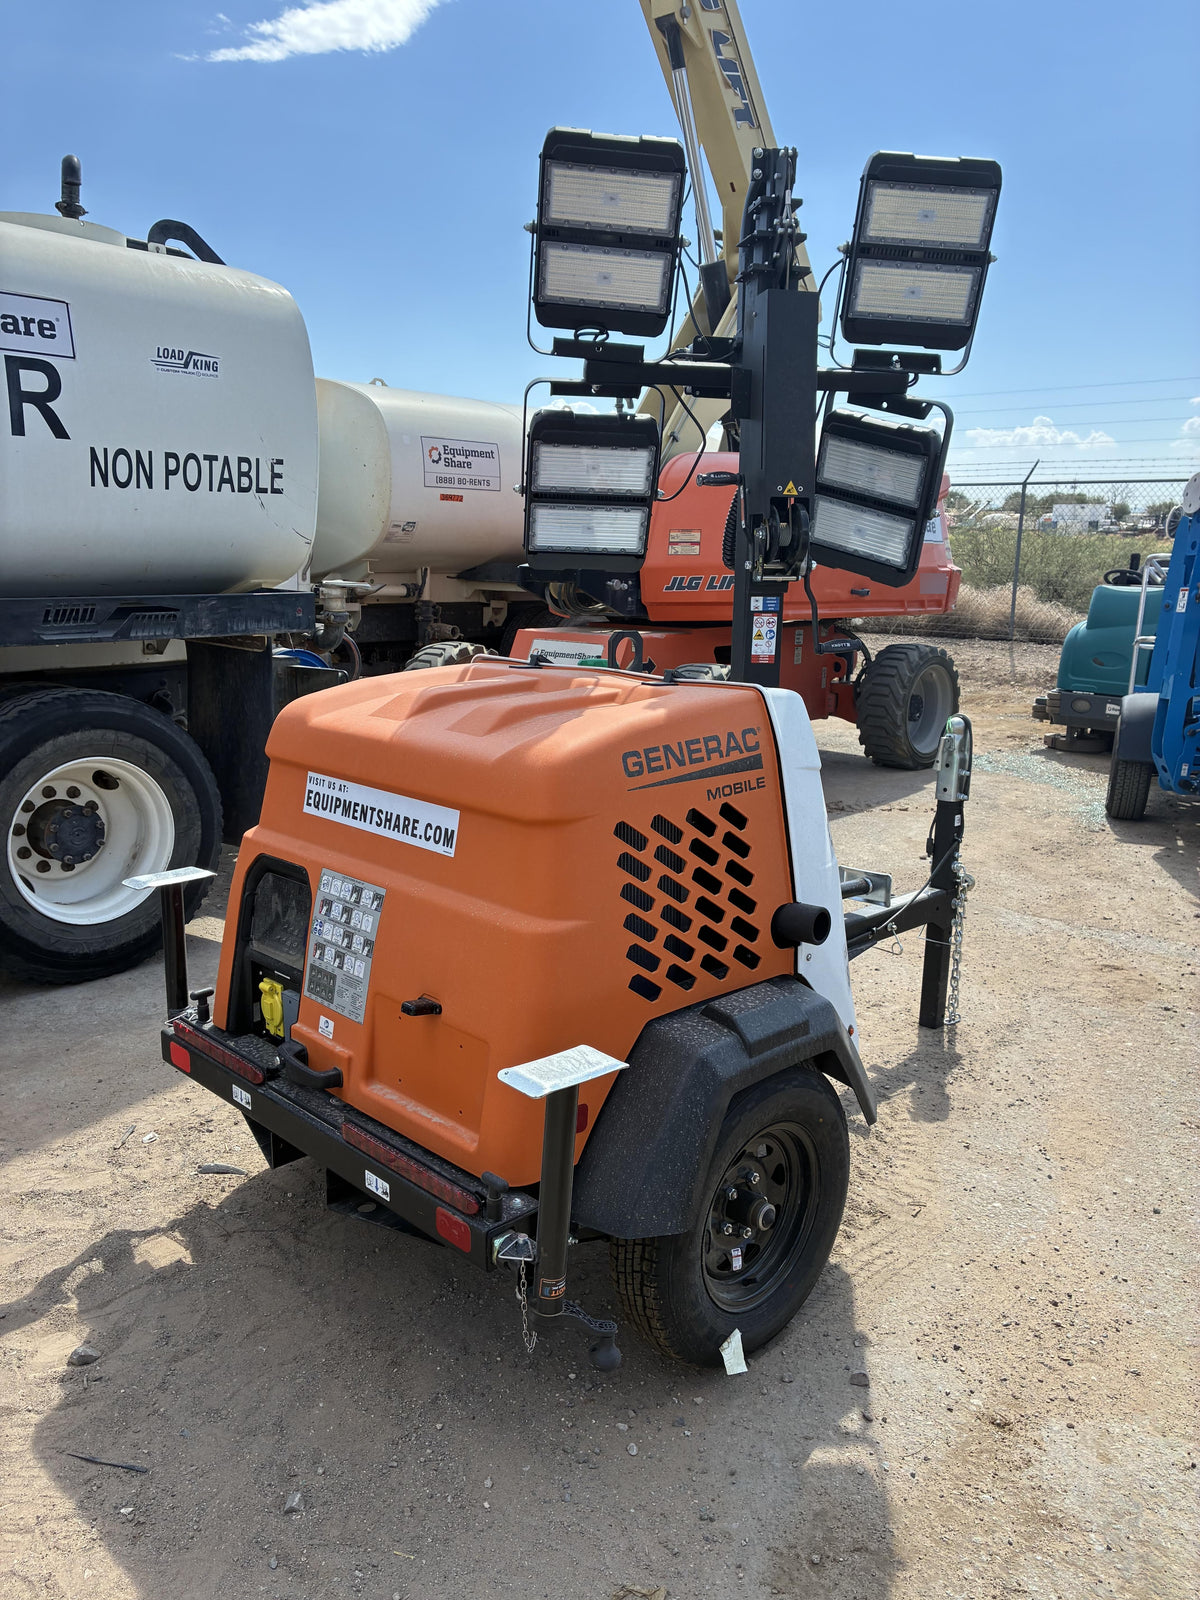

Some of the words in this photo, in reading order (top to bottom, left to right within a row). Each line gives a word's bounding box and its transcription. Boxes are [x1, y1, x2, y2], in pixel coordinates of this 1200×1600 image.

[156, 346, 184, 361] LOAD
[192, 358, 219, 373] KING
[4, 354, 71, 440] R
[442, 444, 495, 459] Equipment
[443, 457, 472, 469] Share
[89, 446, 153, 489] NON
[164, 451, 284, 495] POTABLE
[457, 477, 491, 487] 80-RENTS
[663, 575, 704, 592] JLG
[622, 728, 760, 778] GENERAC
[308, 775, 325, 788] VISIT
[327, 780, 336, 791] US
[338, 783, 349, 793] AT:
[706, 776, 766, 801] MOBILE
[305, 789, 456, 850] EQUIPMENTSHARE.COM
